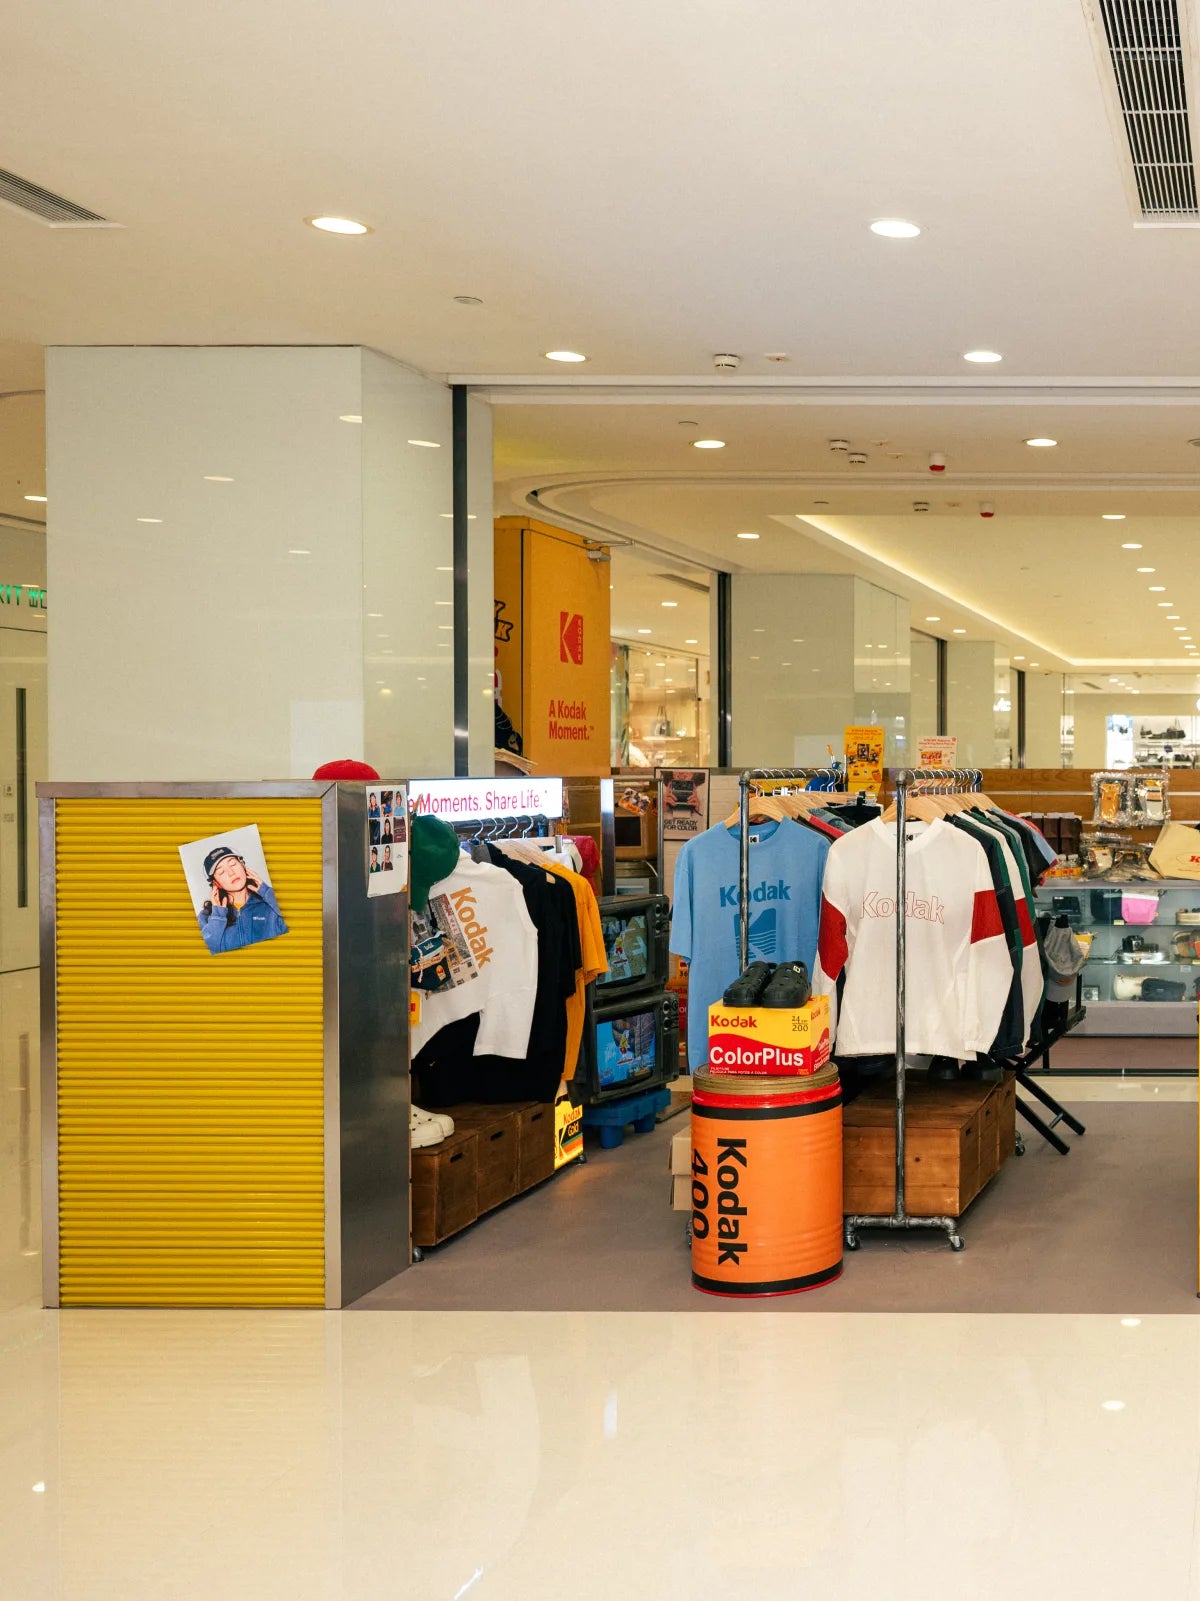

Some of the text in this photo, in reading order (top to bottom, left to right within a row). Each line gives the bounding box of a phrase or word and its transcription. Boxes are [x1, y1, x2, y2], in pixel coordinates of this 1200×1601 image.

[549, 699, 587, 720] A Kodak
[485, 790, 517, 811] Share
[450, 886, 494, 969] Kodak
[710, 1015, 757, 1028] Kodak
[792, 1024, 809, 1032] 200
[710, 1046, 804, 1066] ColorPlus
[563, 1108, 581, 1125] Kodak
[567, 1121, 579, 1137] Gold
[692, 1148, 710, 1240] 400
[717, 1137, 748, 1266] Kodak
